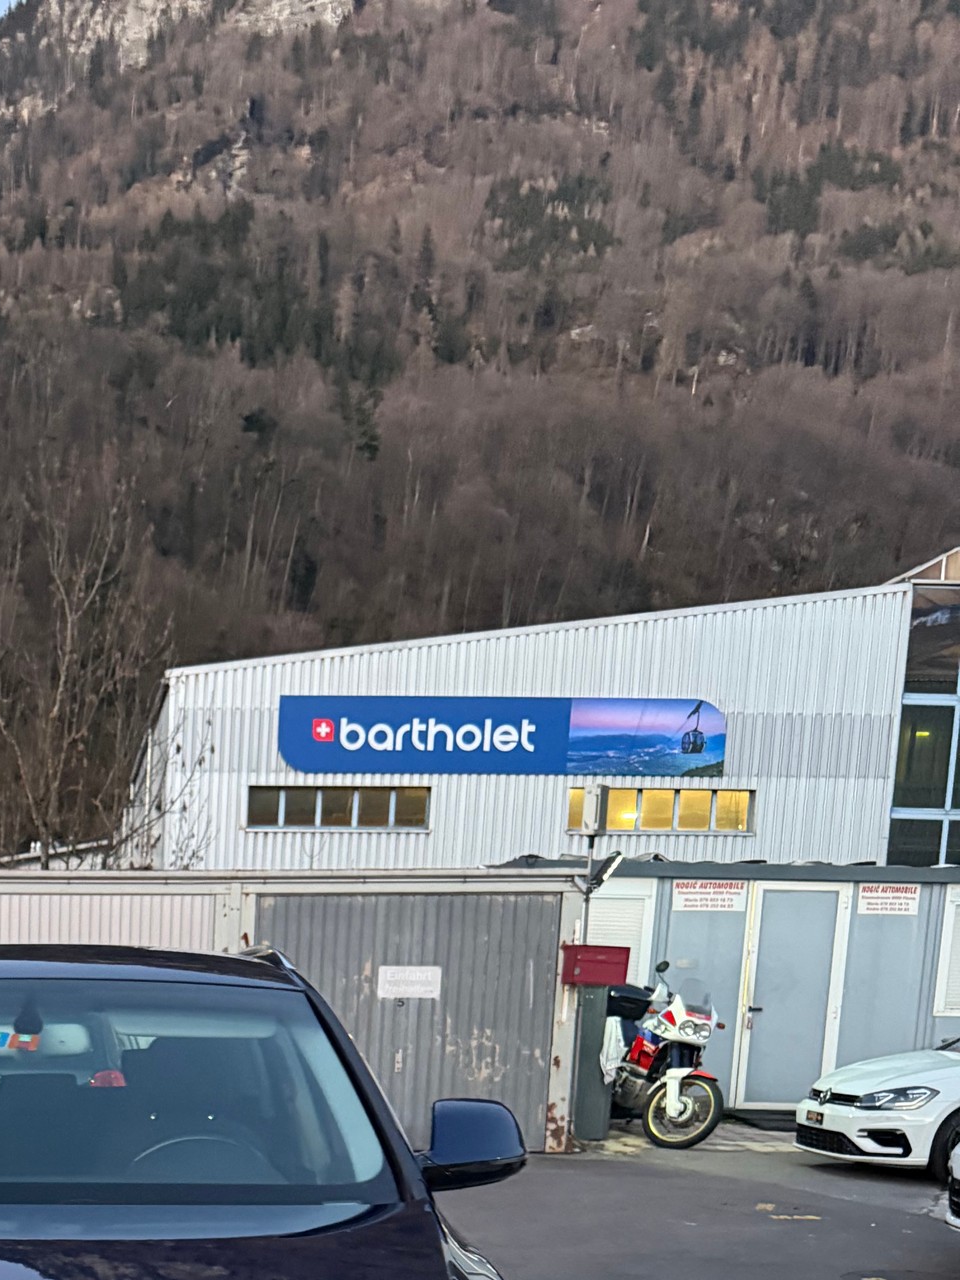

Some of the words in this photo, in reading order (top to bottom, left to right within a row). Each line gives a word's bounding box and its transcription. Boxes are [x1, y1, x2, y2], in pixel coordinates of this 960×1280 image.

[339, 717, 537, 752] bartholet
[699, 882, 745, 890] AUTOMOBILE
[386, 970, 431, 980] Einfahrt
